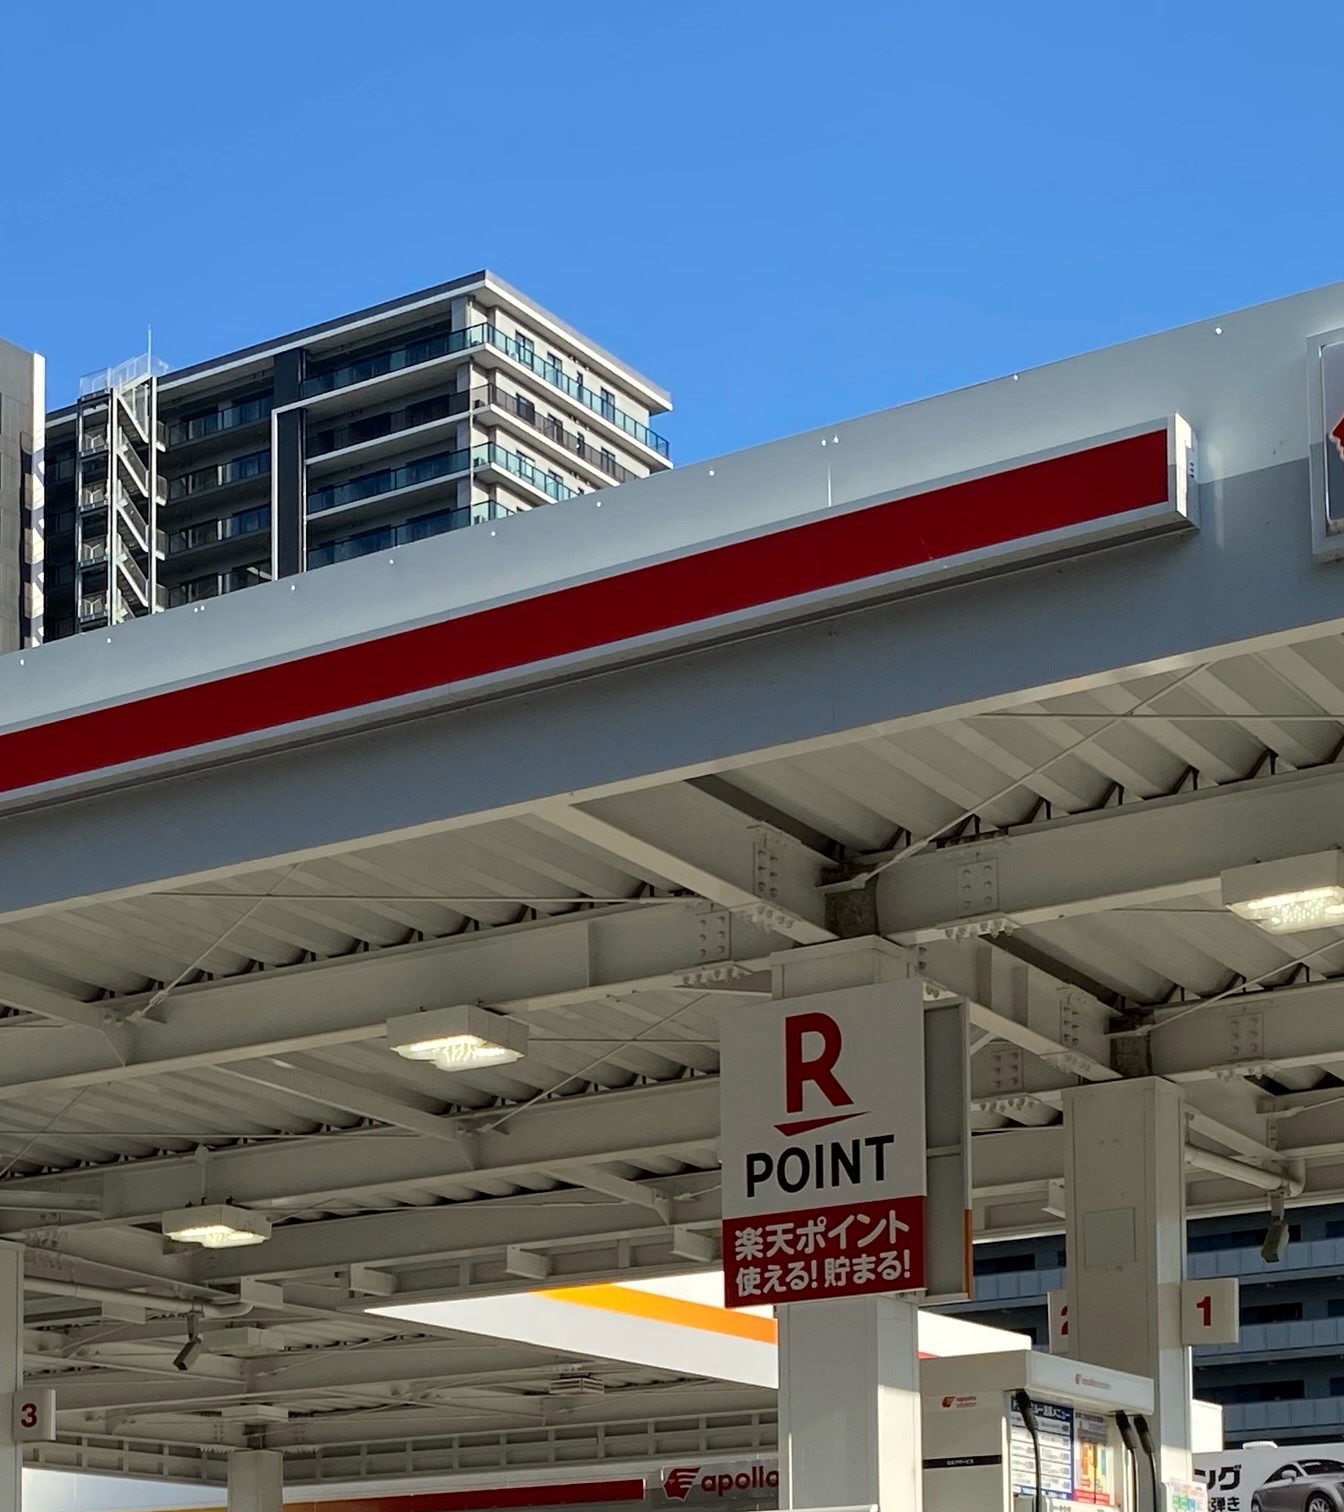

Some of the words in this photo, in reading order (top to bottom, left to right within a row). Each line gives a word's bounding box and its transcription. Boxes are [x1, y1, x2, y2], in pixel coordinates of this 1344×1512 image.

[785, 1012, 854, 1114] R
[745, 1134, 895, 1198] POINT
[734, 1209, 909, 1262] 楽天ポイント
[1196, 1296, 1212, 1326] 1
[21, 1403, 37, 1428] 3
